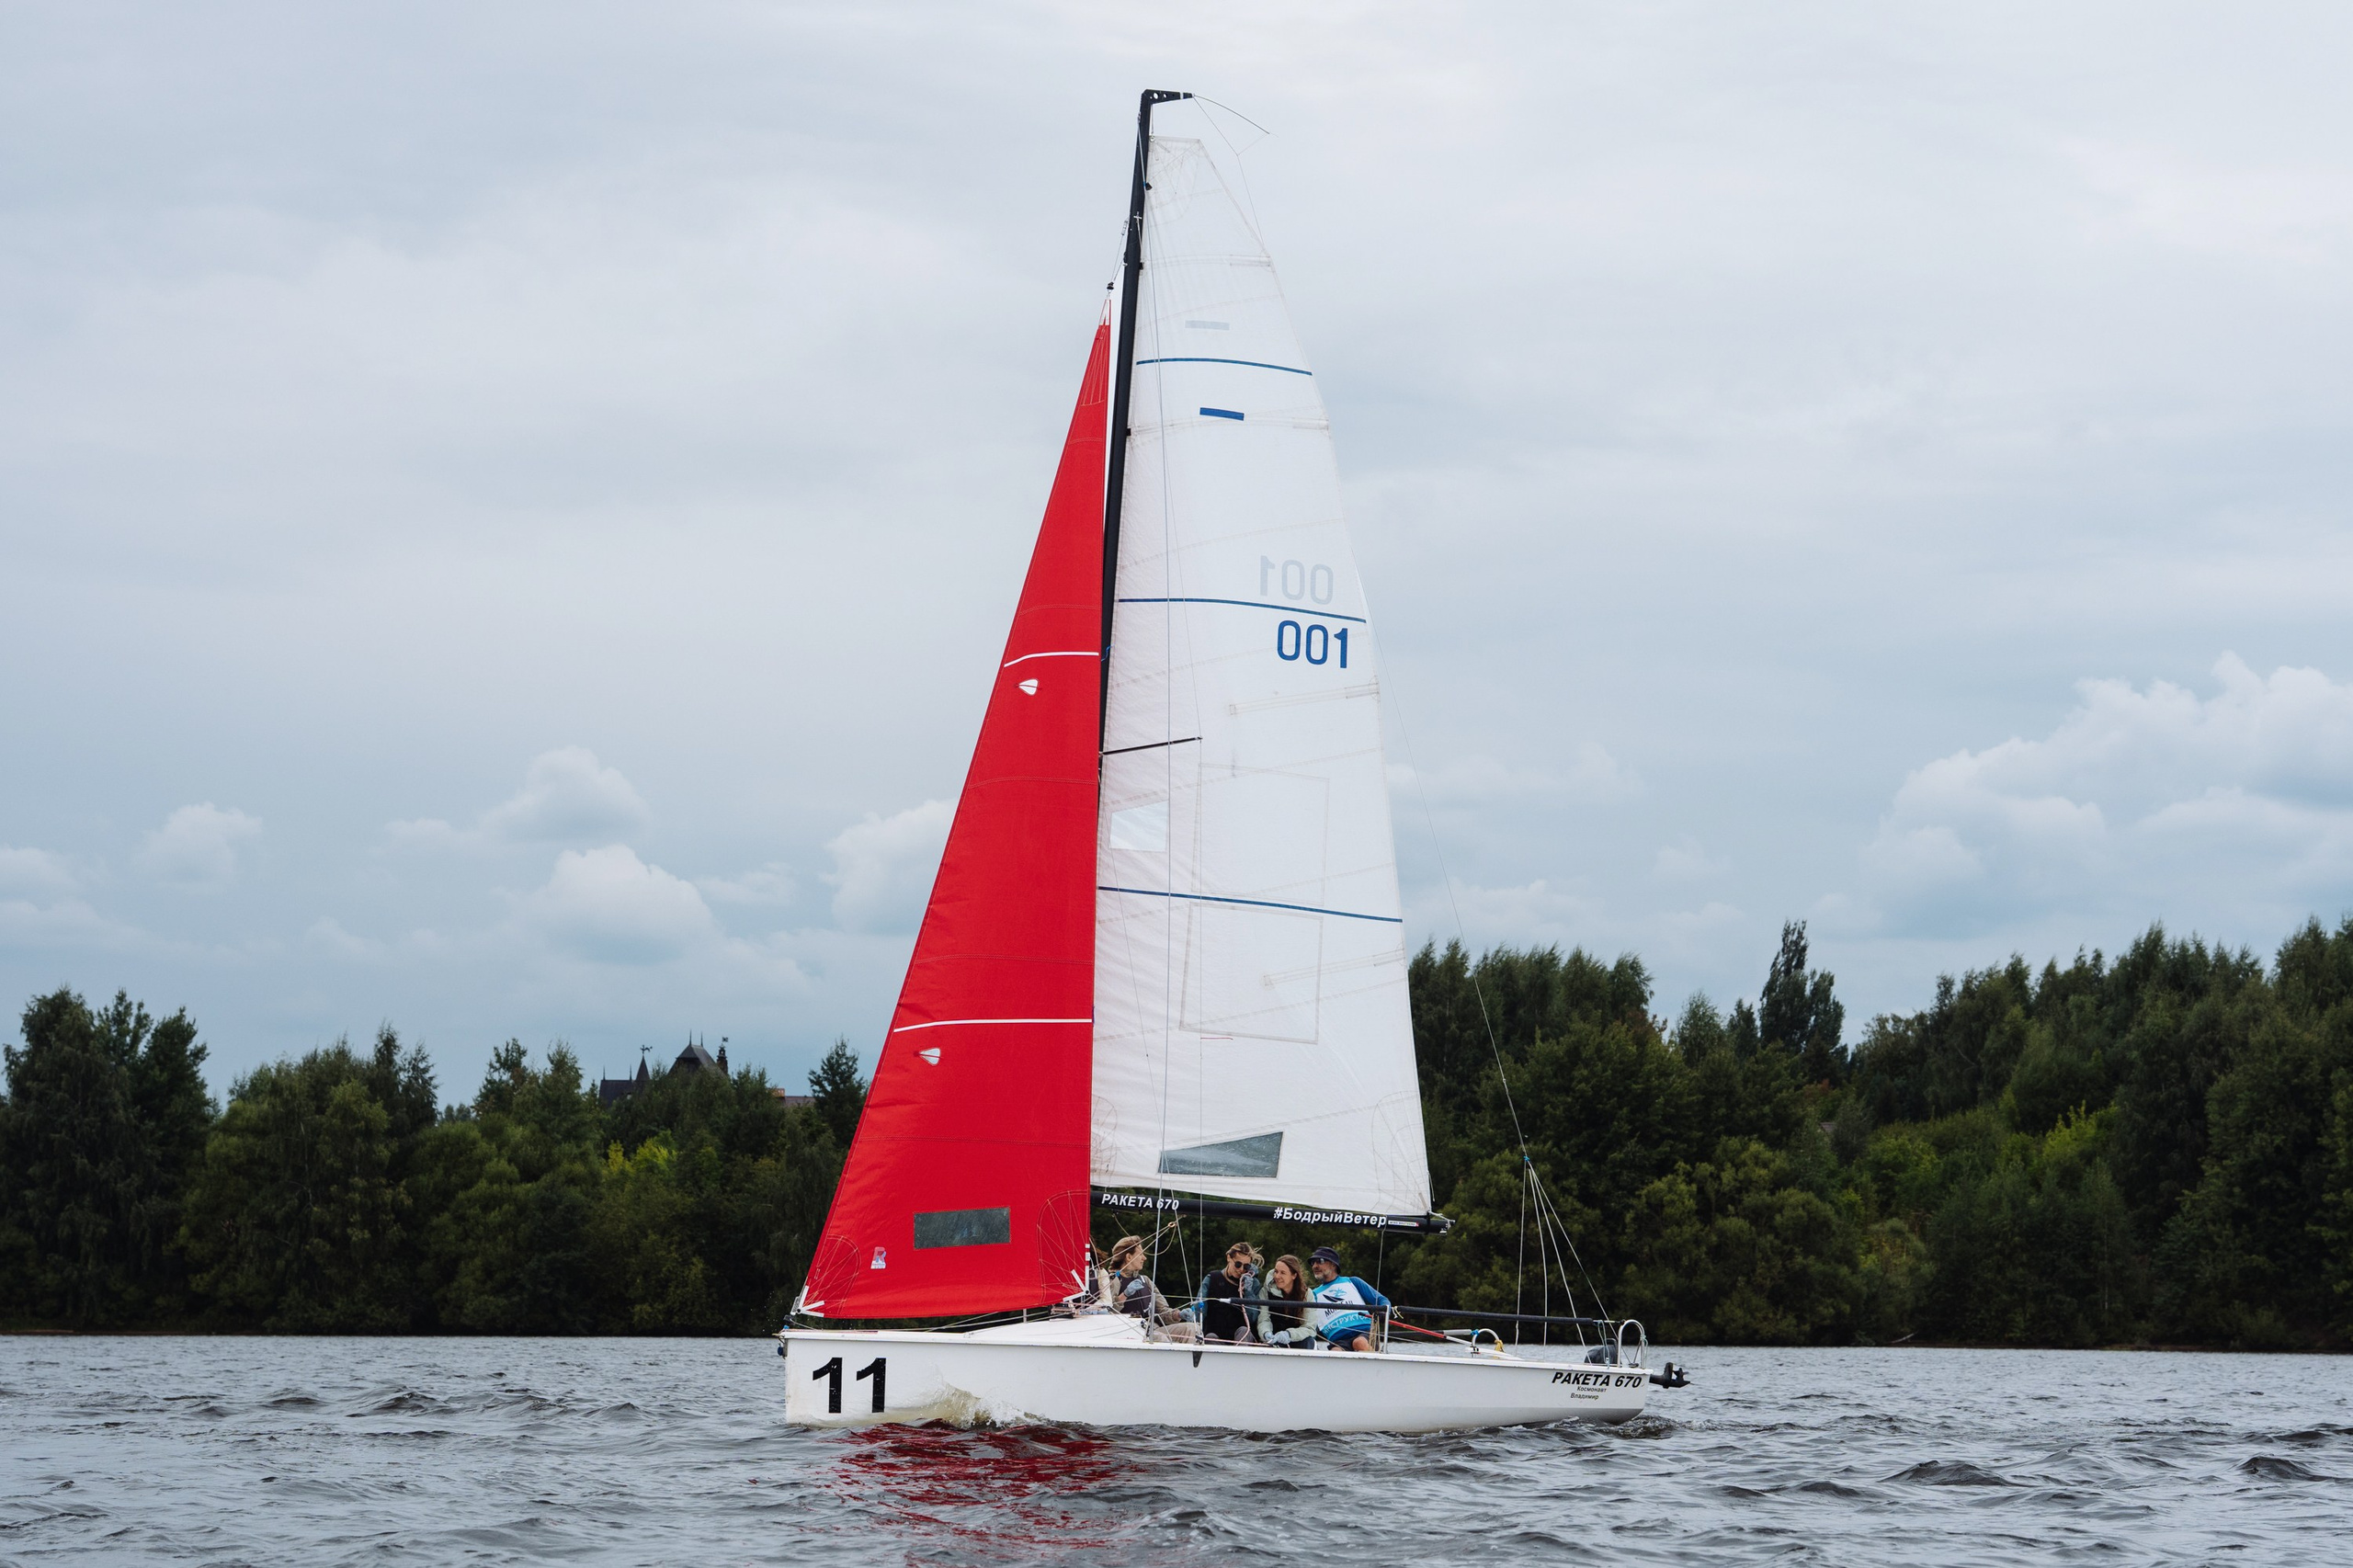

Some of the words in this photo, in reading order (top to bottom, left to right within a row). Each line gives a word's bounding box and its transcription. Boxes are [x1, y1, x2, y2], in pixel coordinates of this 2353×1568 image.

[1277, 619, 1348, 669] 001
[1101, 1193, 1154, 1209] РАКЕТА
[1156, 1199, 1180, 1211] 670
[1273, 1206, 1387, 1228] #БодрыйВетер
[812, 1357, 887, 1414] 11
[1552, 1371, 1609, 1387] РАКЕТА
[1614, 1375, 1643, 1389] 670
[1576, 1385, 1608, 1393] Космонавт
[1570, 1392, 1599, 1401] Владимир
